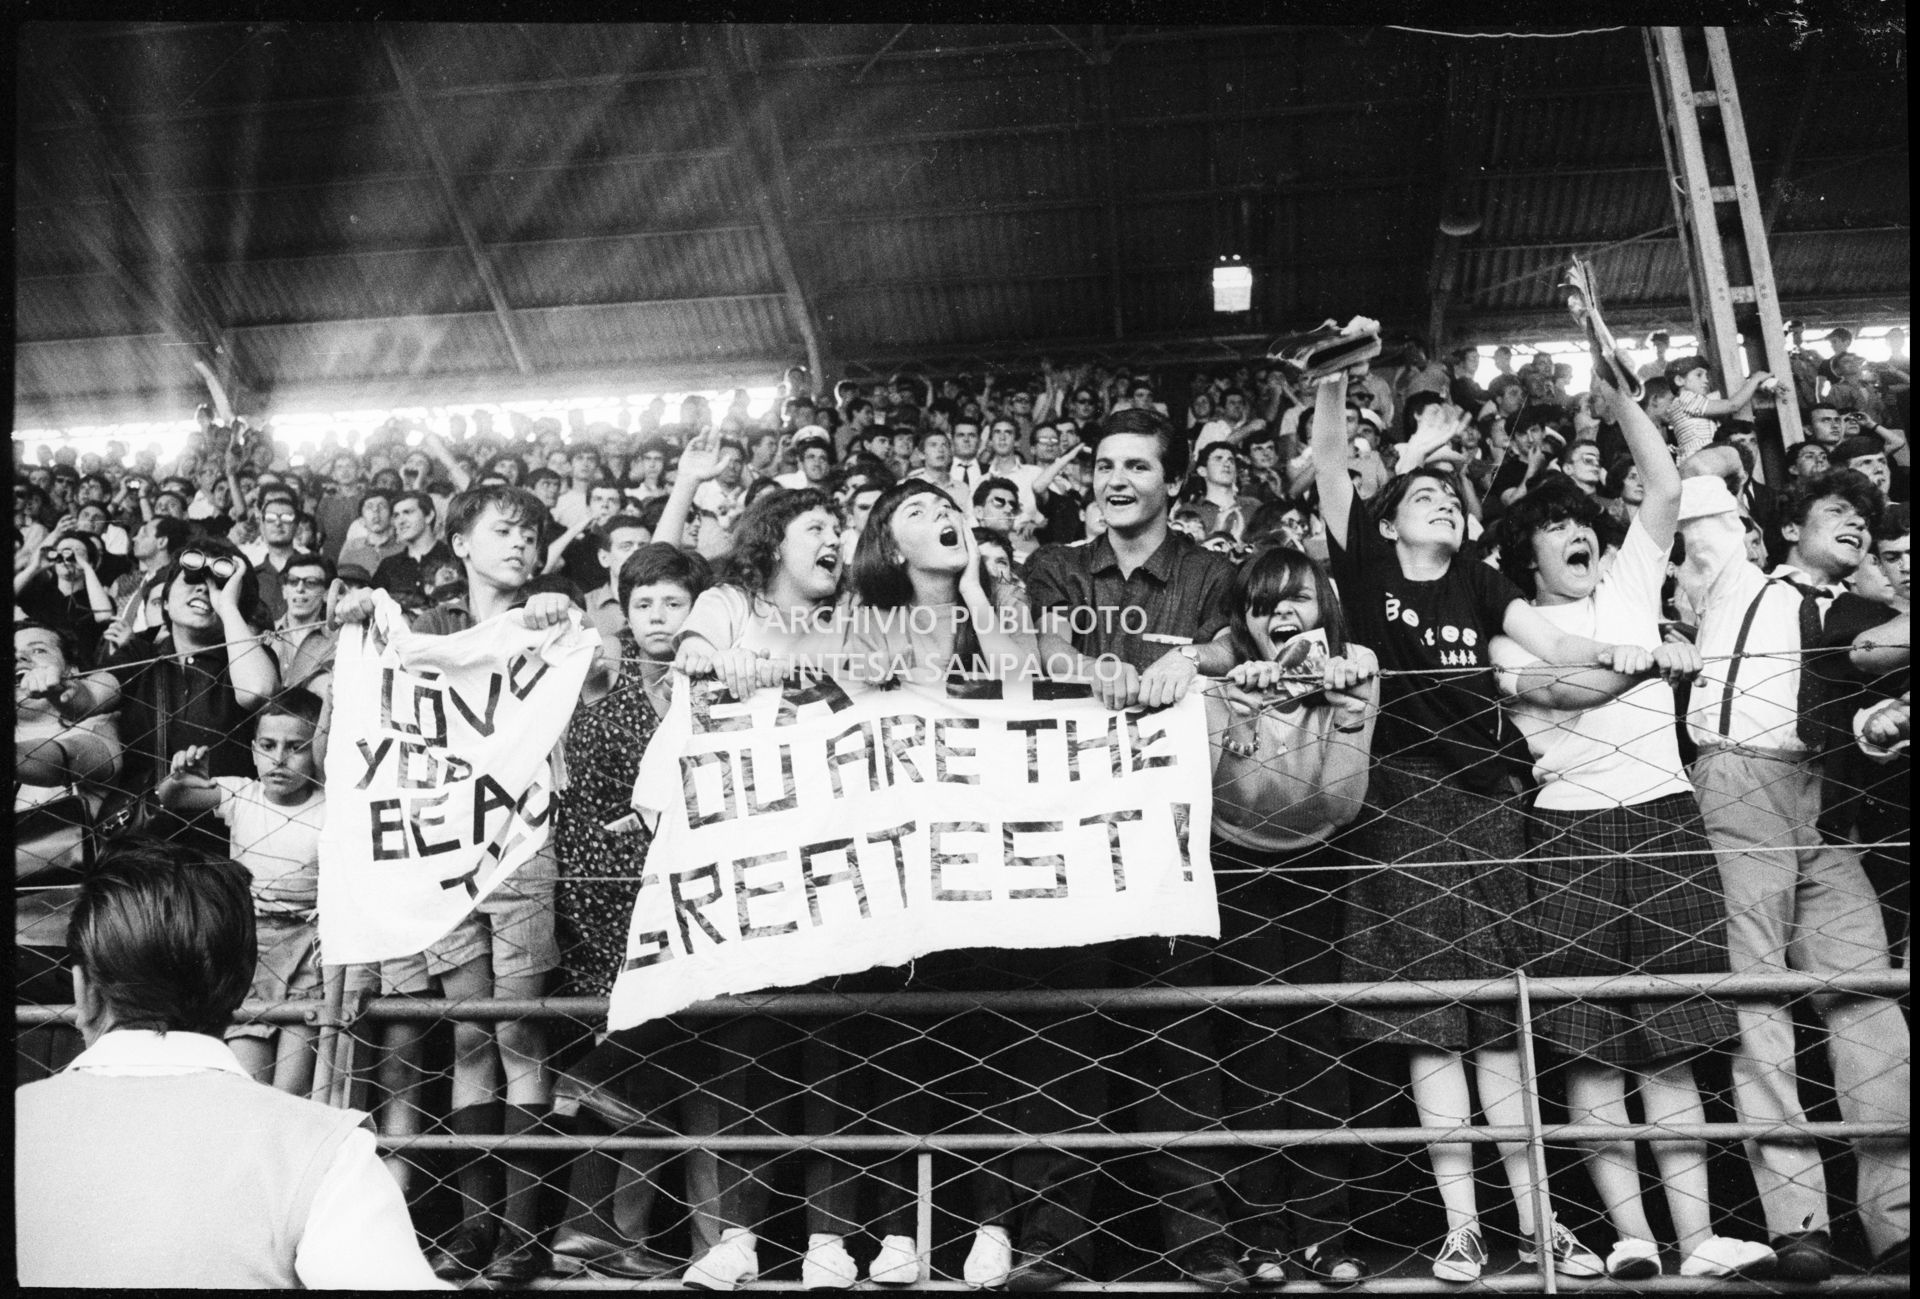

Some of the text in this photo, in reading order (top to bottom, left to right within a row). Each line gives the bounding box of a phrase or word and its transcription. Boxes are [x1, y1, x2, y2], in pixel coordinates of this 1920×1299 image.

[679, 703, 1178, 829] OU ARE THE
